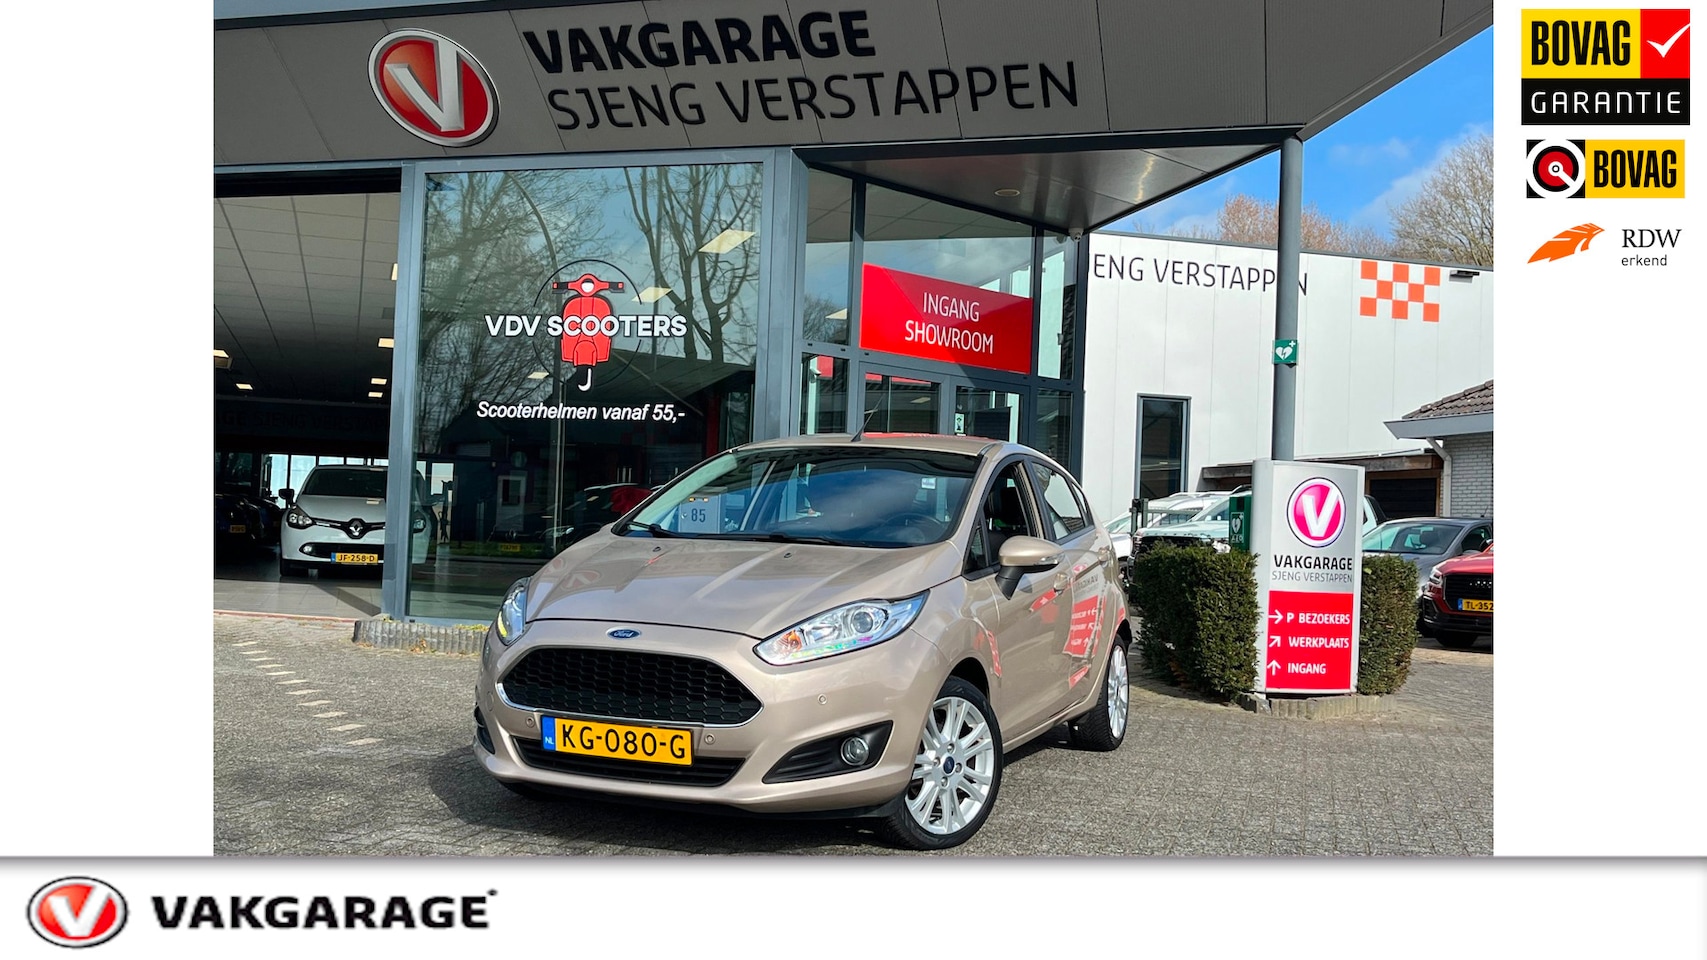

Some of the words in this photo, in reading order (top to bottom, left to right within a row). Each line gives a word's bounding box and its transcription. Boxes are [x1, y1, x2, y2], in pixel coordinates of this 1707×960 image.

[523, 9, 876, 74] VAKGARAGE
[547, 81, 703, 131] SJENG
[718, 61, 1078, 122] VERSTAPPEN
[1153, 257, 1308, 297] VERSTAPPN
[923, 292, 980, 322] INGANG
[485, 315, 541, 337] VDV
[547, 315, 687, 337] SCOOTERS
[904, 319, 994, 354] SHOWROOM
[476, 401, 598, 420] Scooterhelmen
[602, 404, 650, 421] vanaf
[651, 404, 686, 424] 55,-
[691, 508, 706, 523] 85
[338, 554, 375, 562] JF-258-D
[1274, 554, 1353, 571] VAKGARAGE
[1271, 570, 1301, 582] SJENG
[1303, 572, 1353, 584] VERSTAPPEN
[1286, 612, 1295, 624] P
[1298, 612, 1351, 625] BEZOEKERS
[1288, 636, 1350, 649] WERKPLAATS
[1287, 662, 1327, 675] INGANG
[545, 736, 554, 745] NL
[562, 723, 686, 759] KG-080-G
